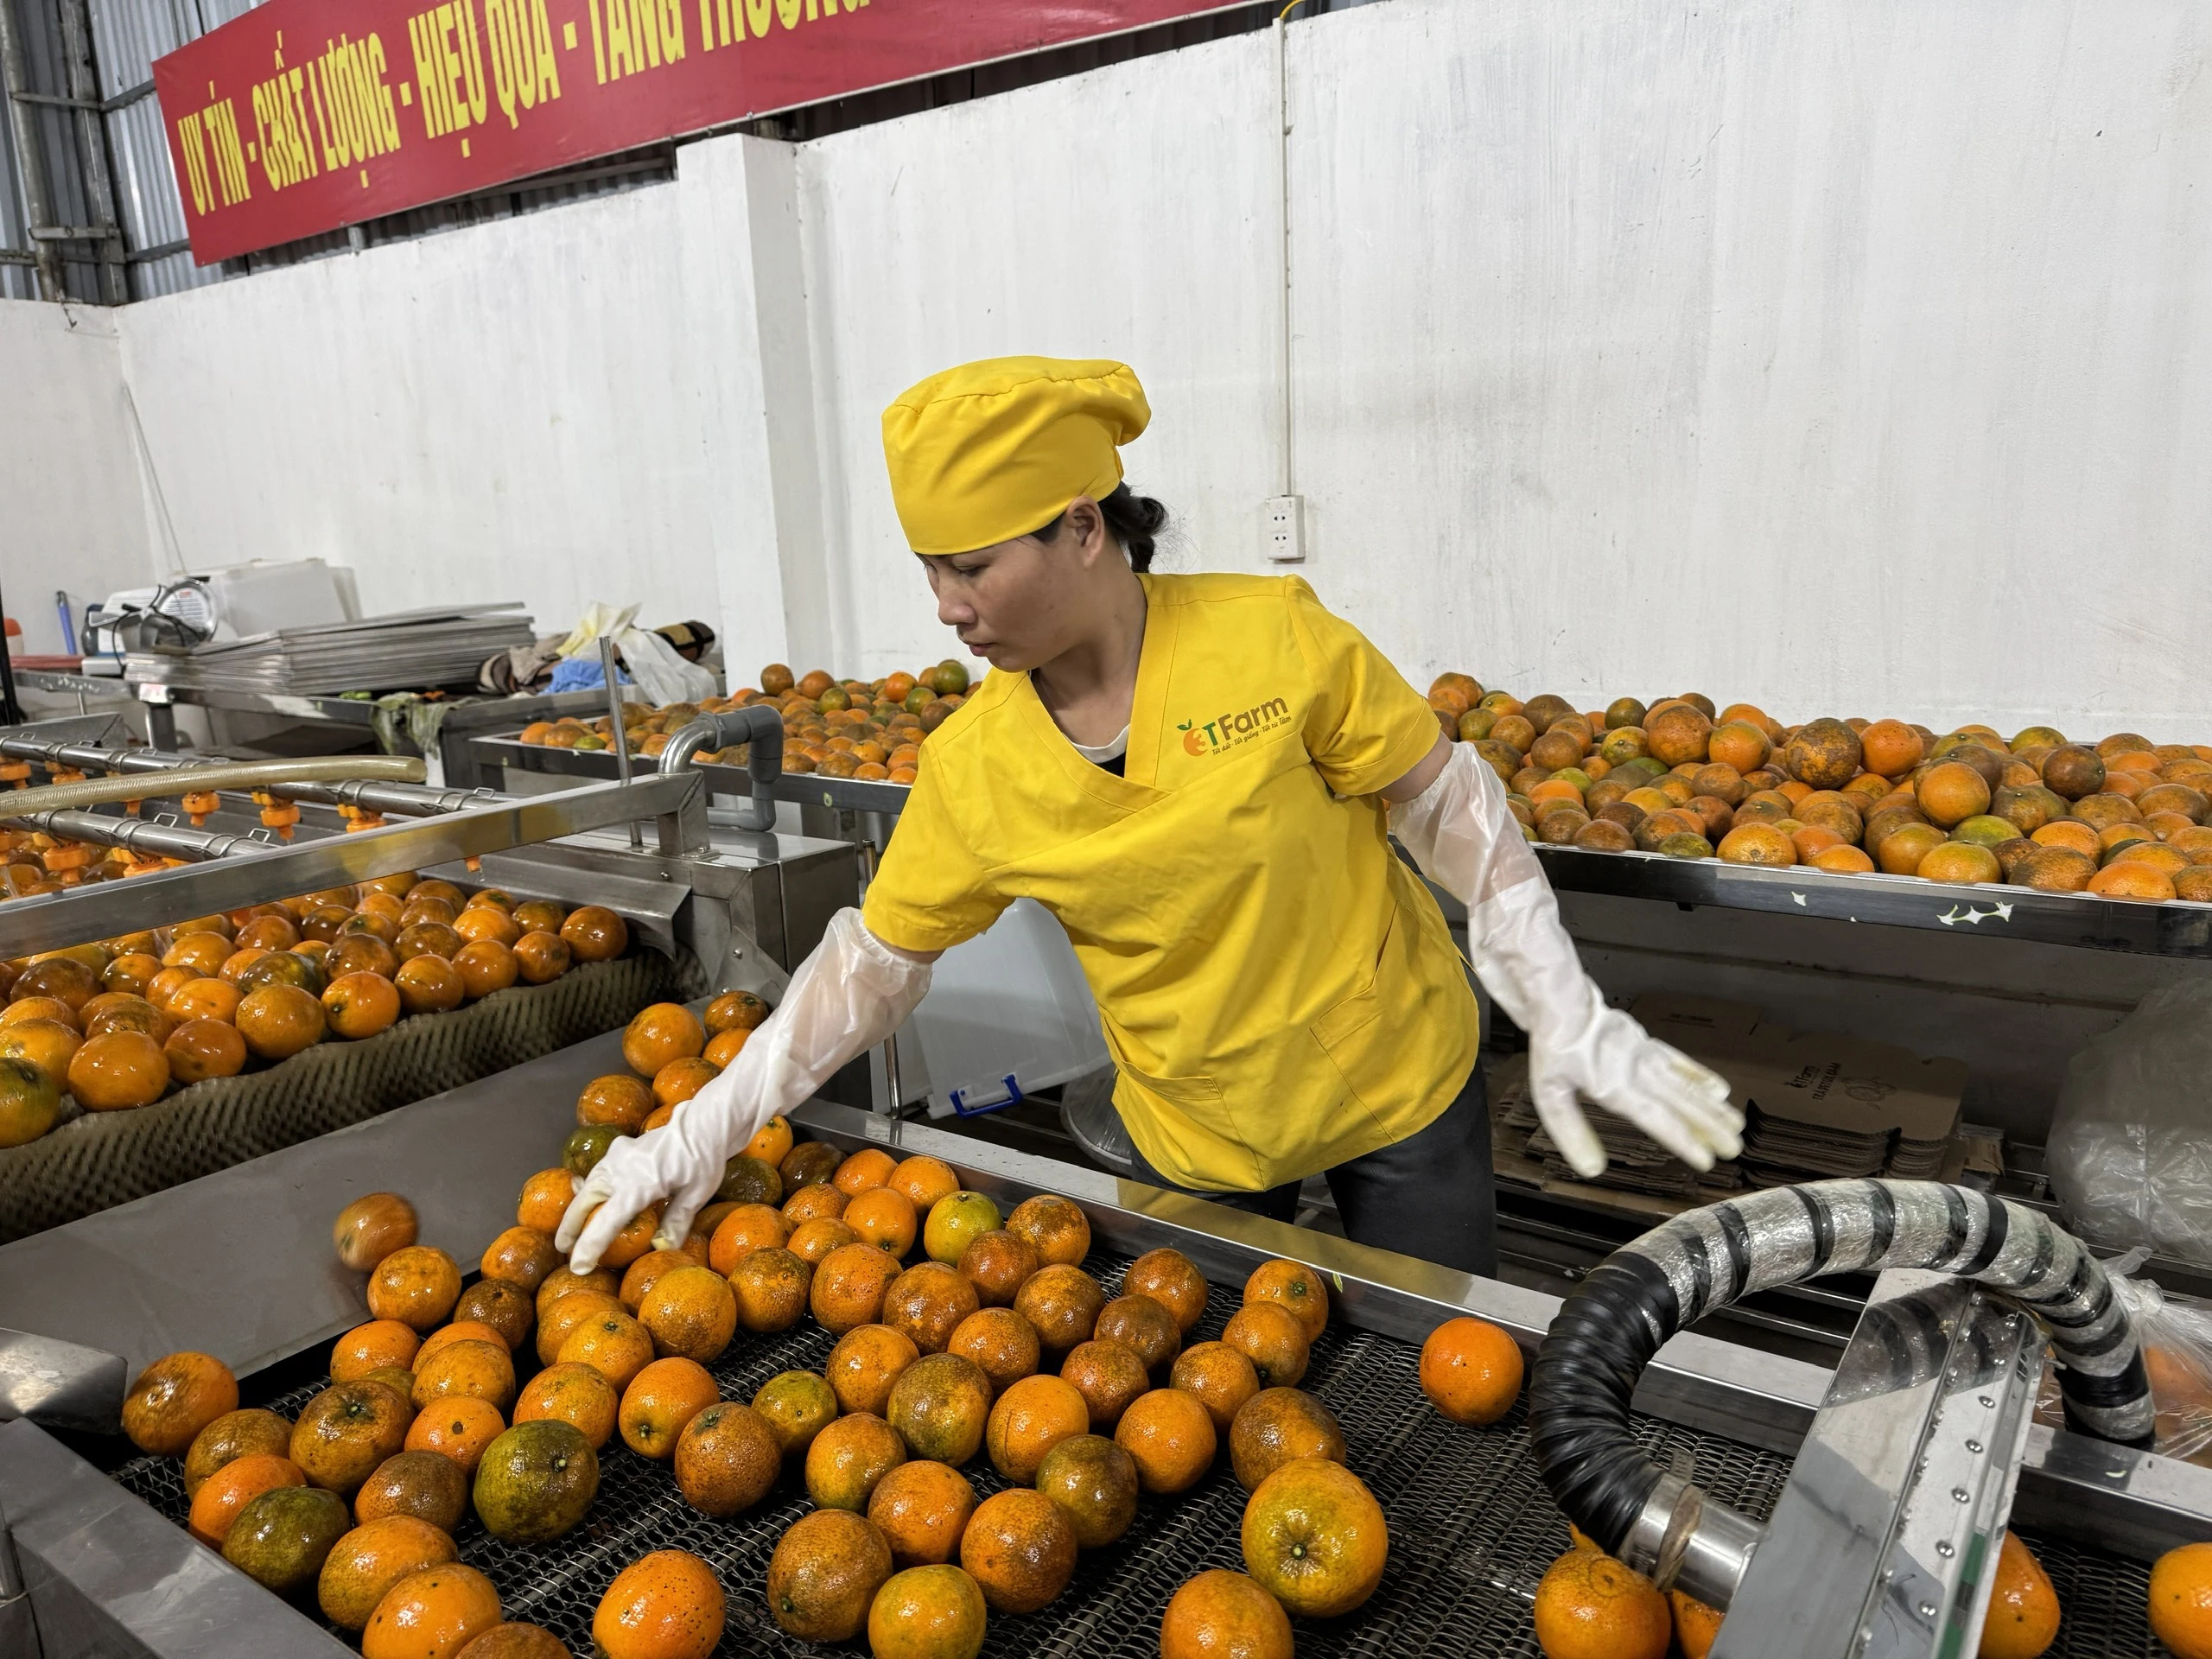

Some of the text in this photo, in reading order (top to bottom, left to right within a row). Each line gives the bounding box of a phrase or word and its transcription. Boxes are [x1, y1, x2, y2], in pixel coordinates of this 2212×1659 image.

[177, 111, 215, 216] UY
[203, 79, 251, 207] TÍN
[252, 30, 318, 192] CHẤT
